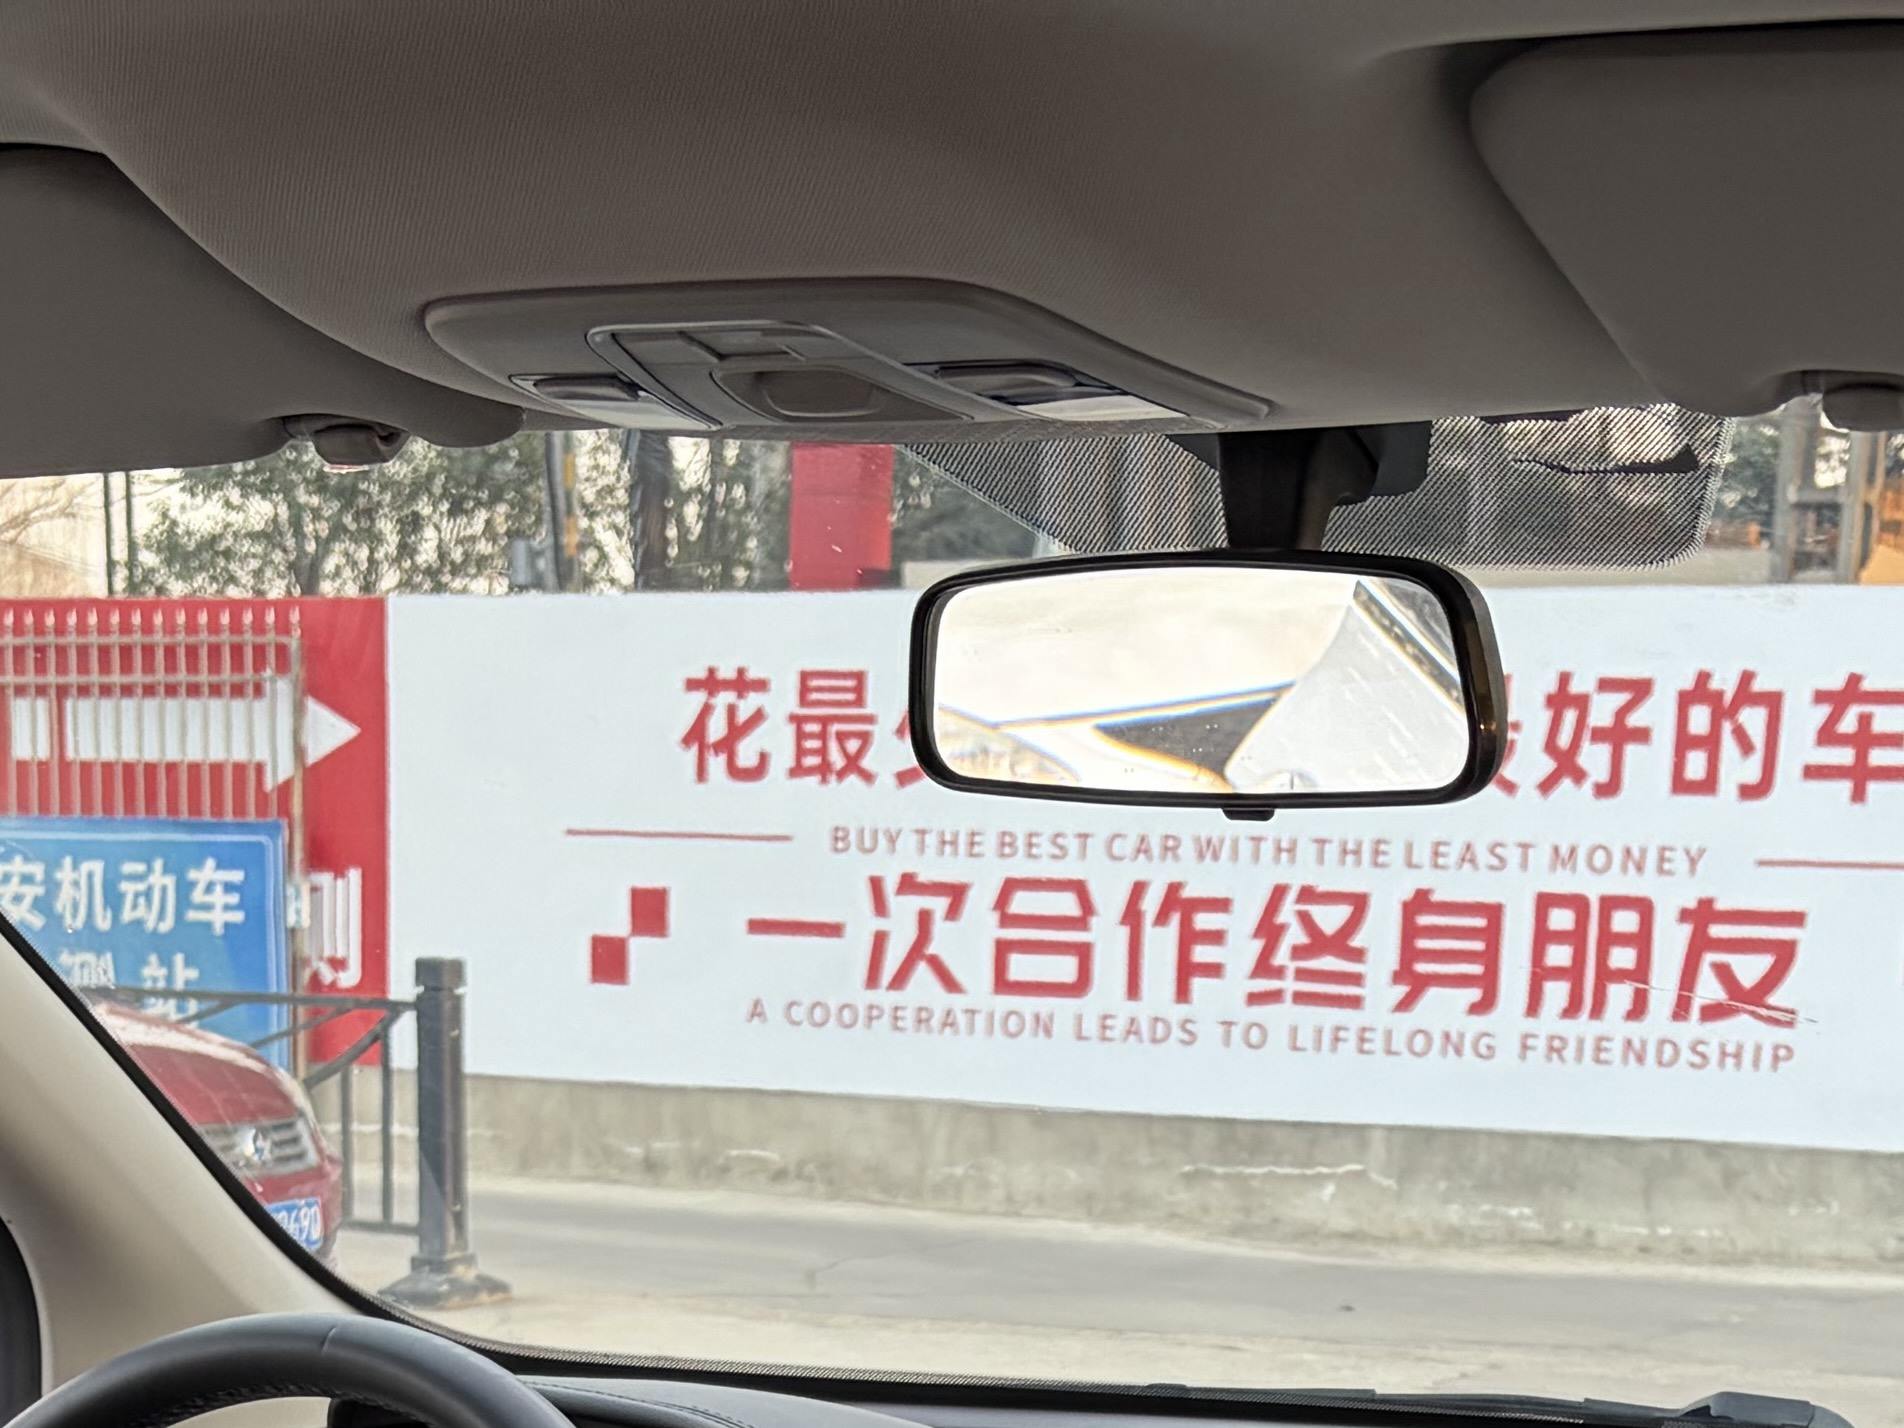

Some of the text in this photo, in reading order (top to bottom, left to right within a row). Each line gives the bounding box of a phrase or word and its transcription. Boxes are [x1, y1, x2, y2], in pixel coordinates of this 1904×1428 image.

[679, 665, 928, 789] 花最
[829, 825, 1708, 878] BUY THE BEST CAR WITH THE LEAST MONEY
[746, 870, 1808, 1029] 一次合作终身朋友
[746, 997, 1798, 1075] A COOPERATION LEADS TO LIFELONG FRIENDSHIP
